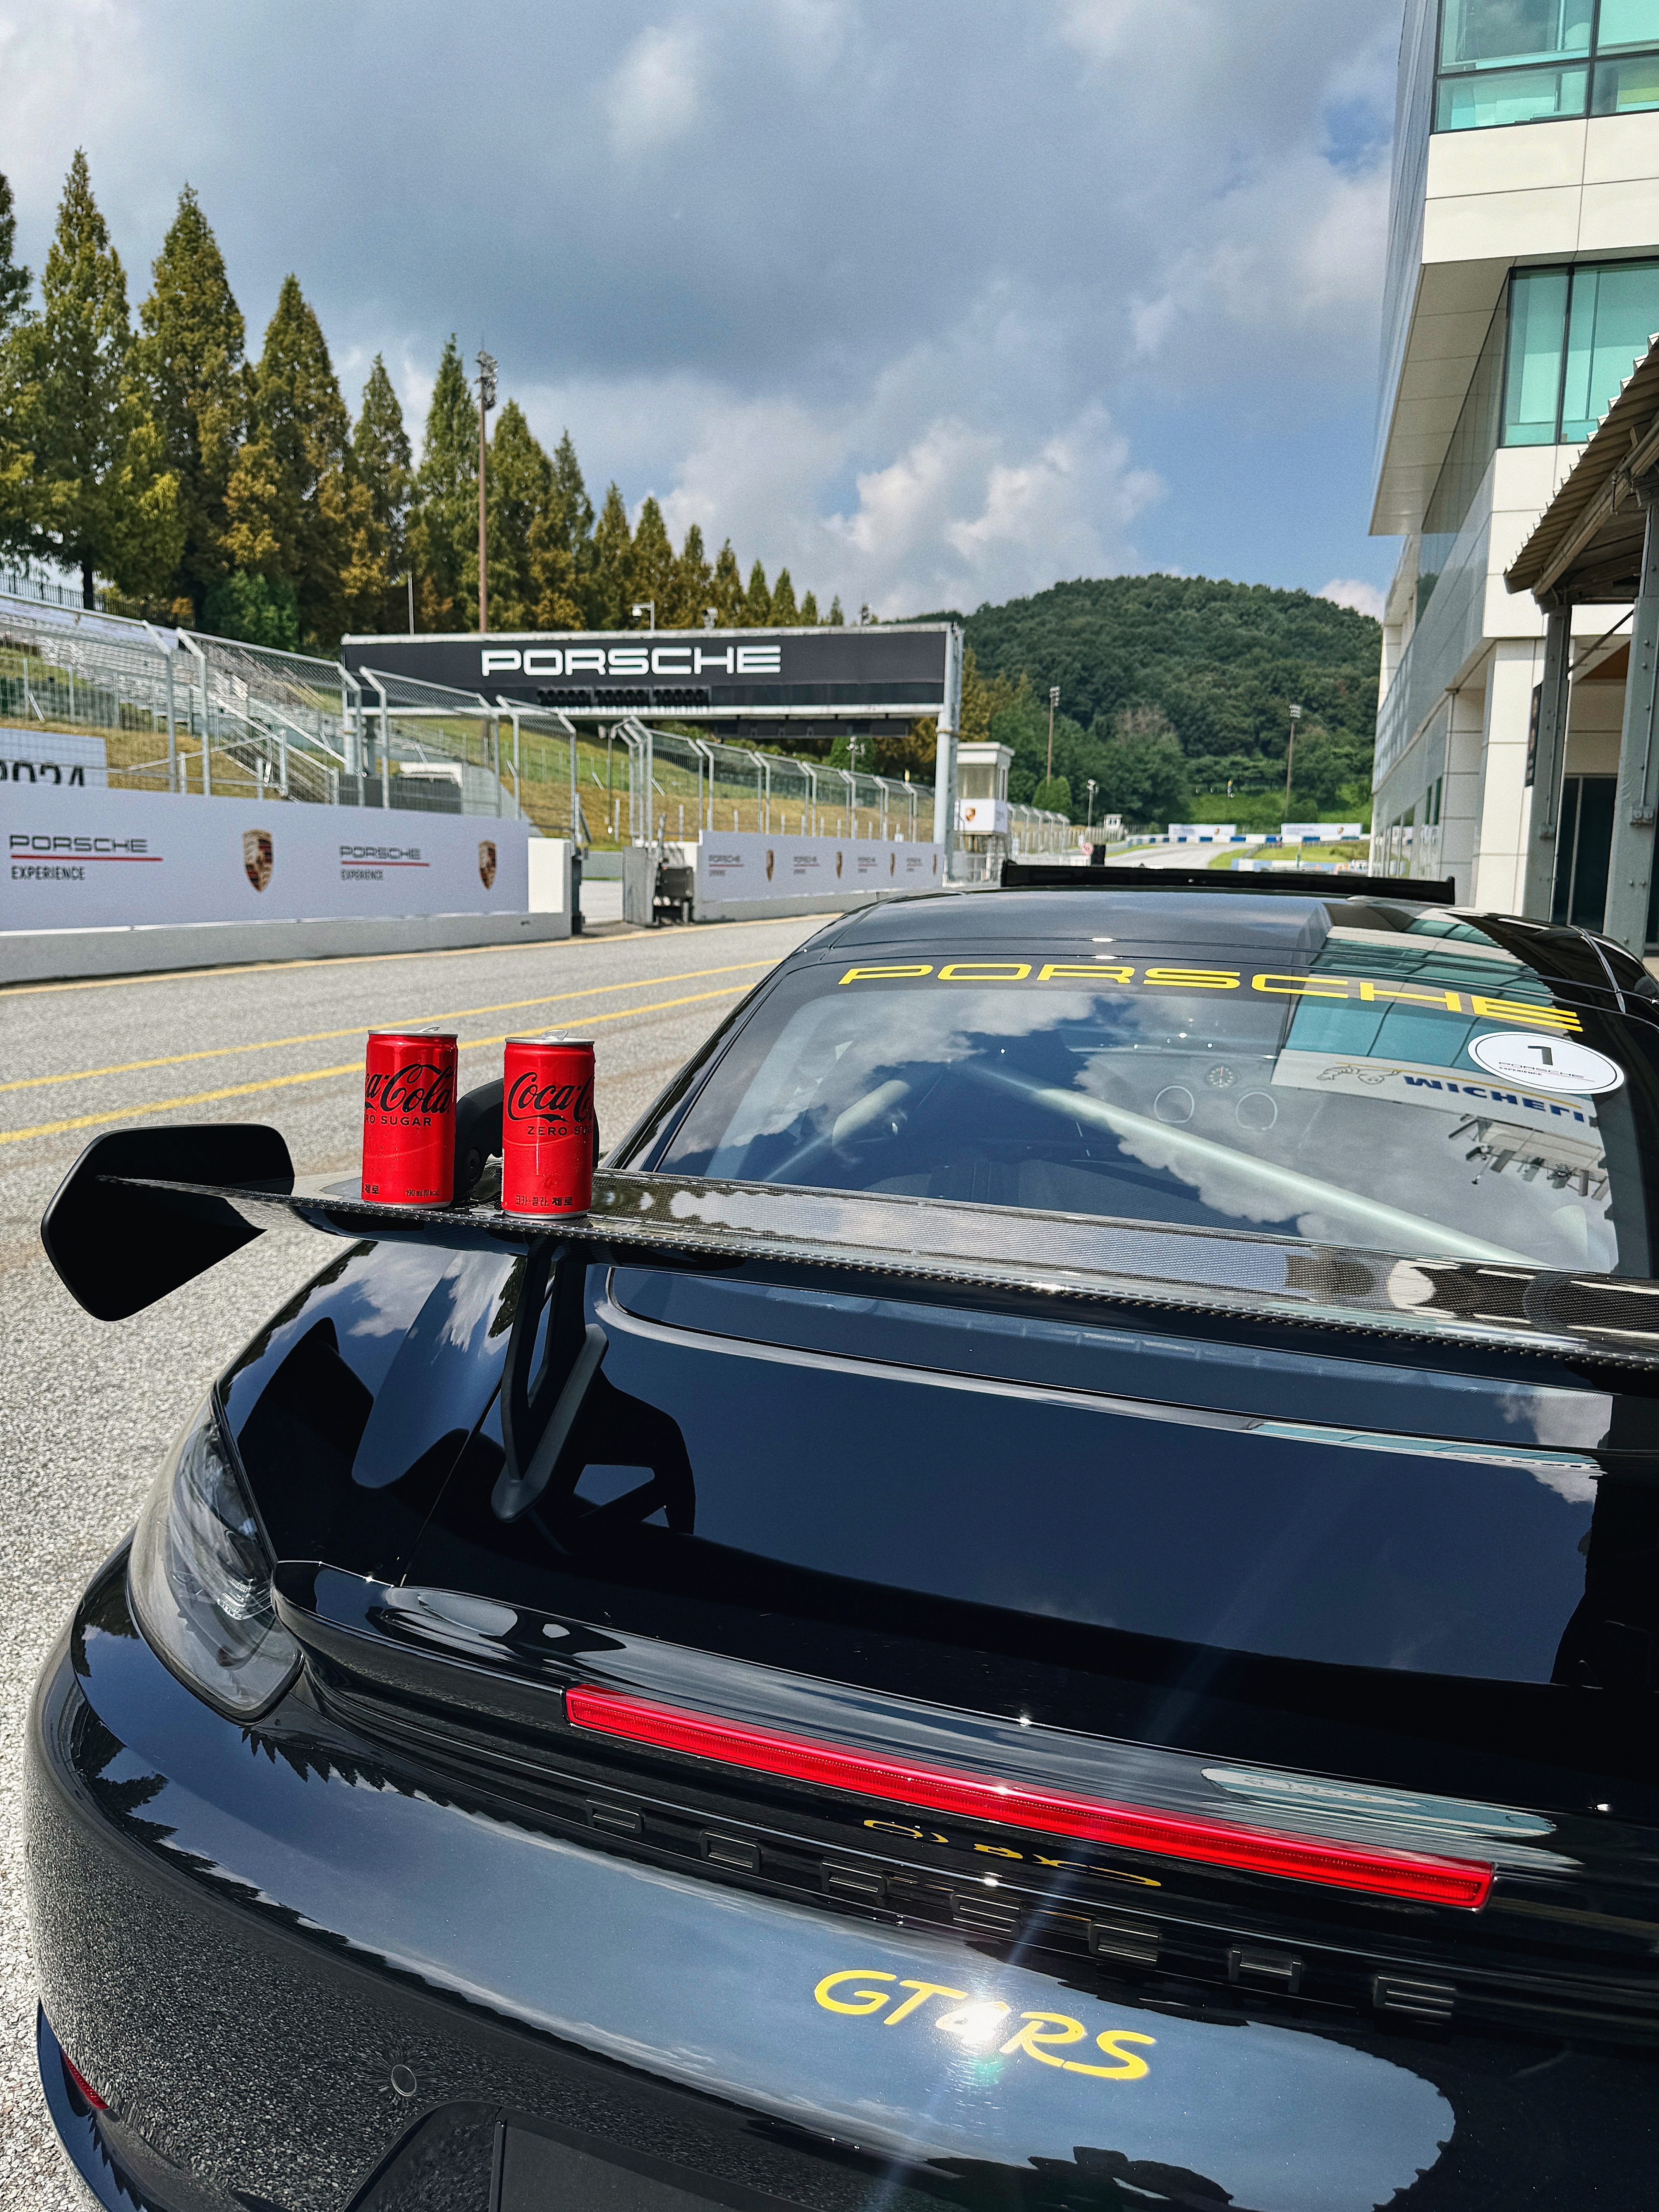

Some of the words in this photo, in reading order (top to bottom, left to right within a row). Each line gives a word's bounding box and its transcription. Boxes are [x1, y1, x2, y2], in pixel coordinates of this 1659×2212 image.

[481, 645, 781, 677] PORSCHE
[9, 834, 149, 853] PORSCHE
[340, 846, 421, 860] PORSCHE
[838, 963, 1584, 1033] PORSCHE
[1527, 1045, 1553, 1066] 1
[1499, 1061, 1584, 1079] PORSCHE
[1499, 1066, 1542, 1076] EXPERIENCE
[381, 1115, 432, 1127] SUGAR
[527, 1125, 568, 1136] ZERO
[365, 1184, 380, 1194] 제로
[551, 1196, 573, 1206] 제로
[584, 1797, 1457, 2021] PORSCHE
